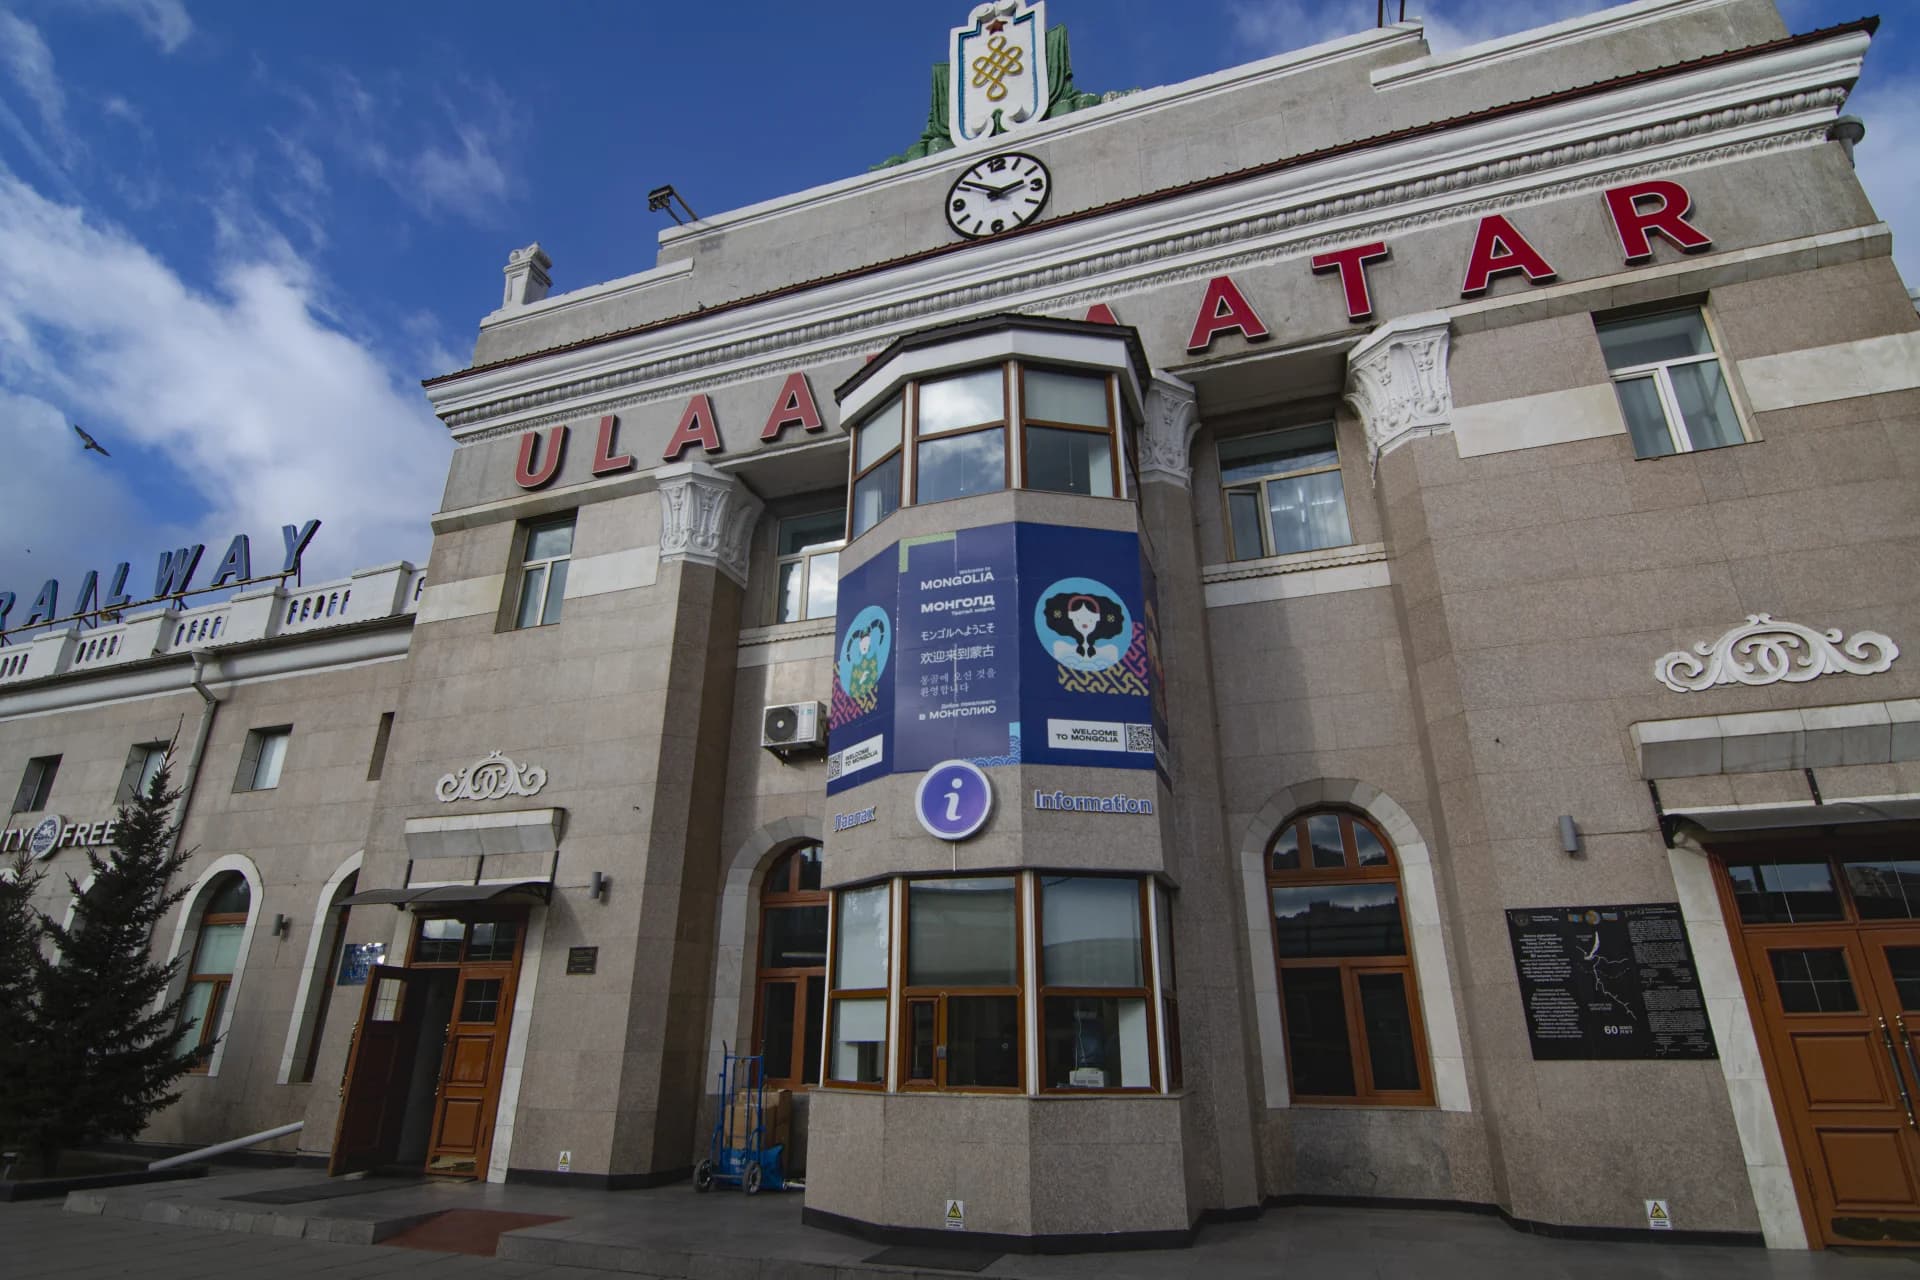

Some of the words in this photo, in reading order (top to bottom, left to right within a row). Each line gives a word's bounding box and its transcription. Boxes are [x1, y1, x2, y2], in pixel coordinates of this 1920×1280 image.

[987, 158, 1006, 173] 12
[1030, 178, 1043, 192] 3
[952, 198, 966, 212] 9
[990, 219, 1004, 234] 6
[920, 571, 995, 591] MONGOLIA
[920, 595, 996, 614] МОНГОЛД
[920, 622, 996, 641] モンゴルへようこそ
[920, 644, 996, 665] 欢迎来到蒙古
[929, 705, 997, 720] МОНГОЛИЮ
[1056, 733, 1069, 741] TO
[1071, 734, 1119, 743] MONGOLIA
[1071, 728, 1118, 737] WELCOME
[1034, 789, 1153, 814] Information
[0, 827, 32, 852] TY
[58, 819, 119, 848] FREE
[1604, 1025, 1618, 1035] 60
